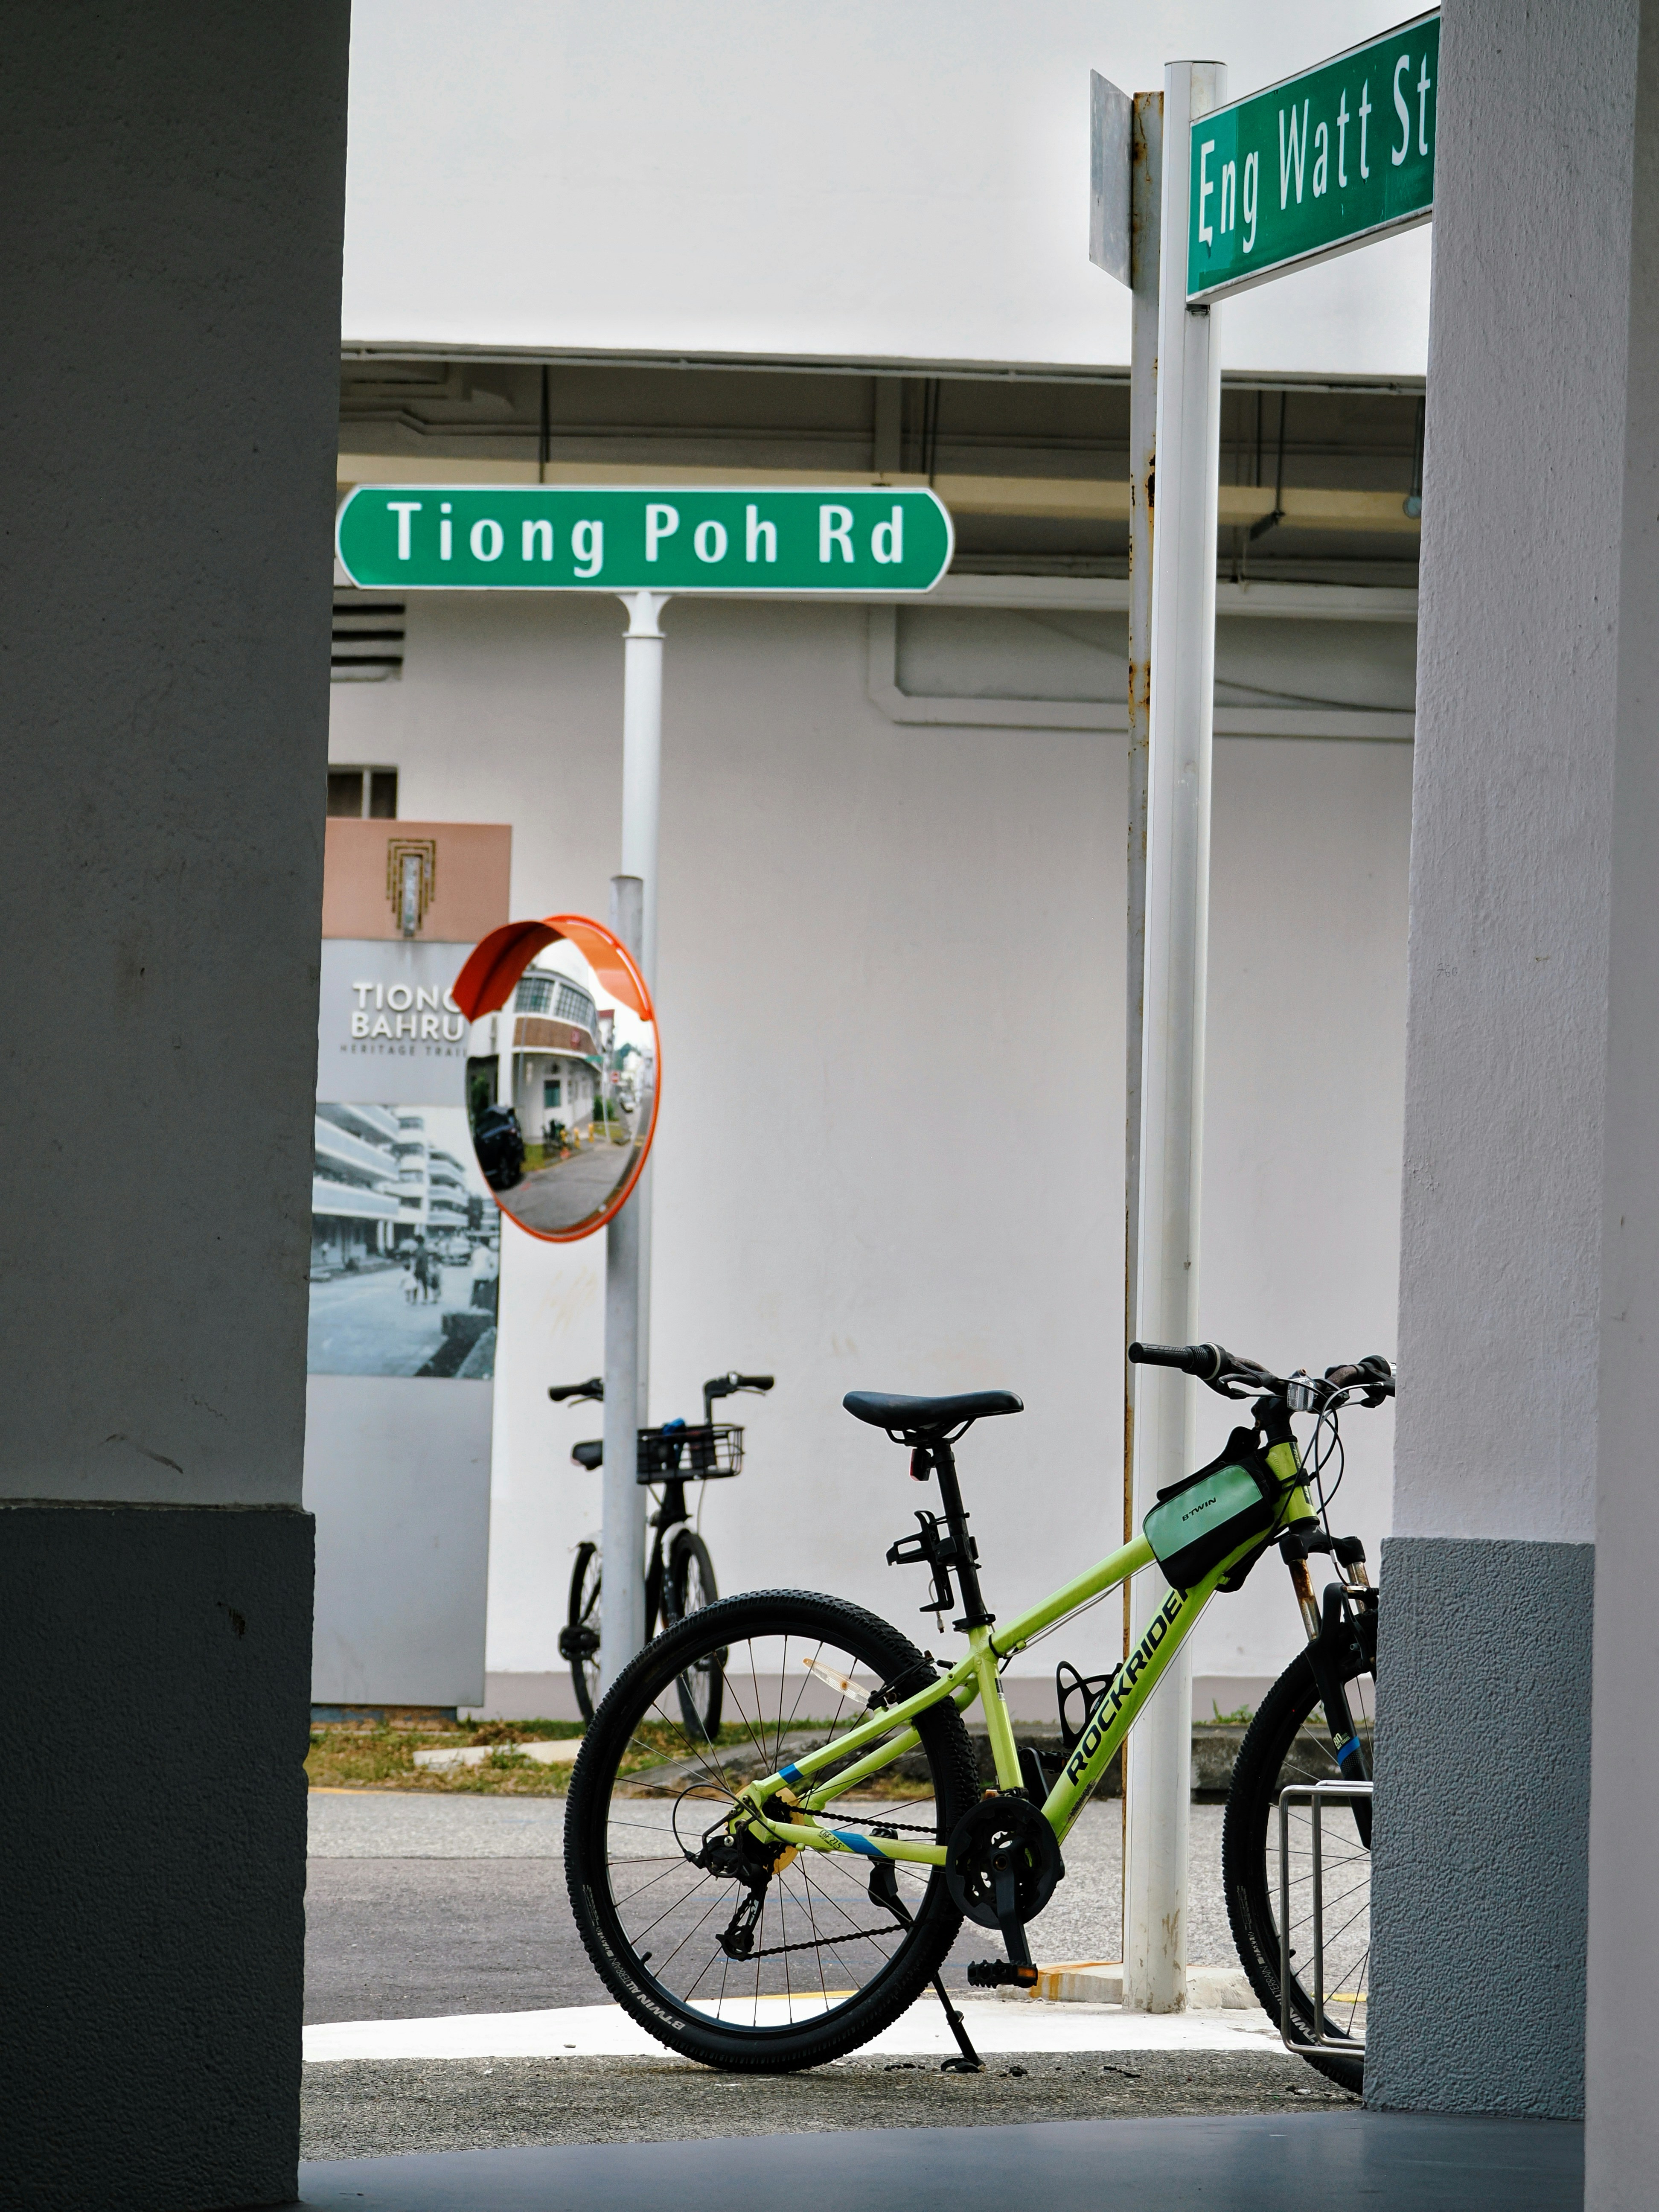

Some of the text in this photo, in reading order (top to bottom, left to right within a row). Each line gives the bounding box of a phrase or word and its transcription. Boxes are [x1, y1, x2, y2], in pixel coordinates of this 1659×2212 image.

[1199, 52, 1430, 253] Eng Watt St
[387, 501, 903, 578] Tiong Poh Rd
[351, 1011, 464, 1042] BAHRU
[340, 1044, 415, 1056] HERITAGE
[1333, 1733, 1342, 1747] 80
